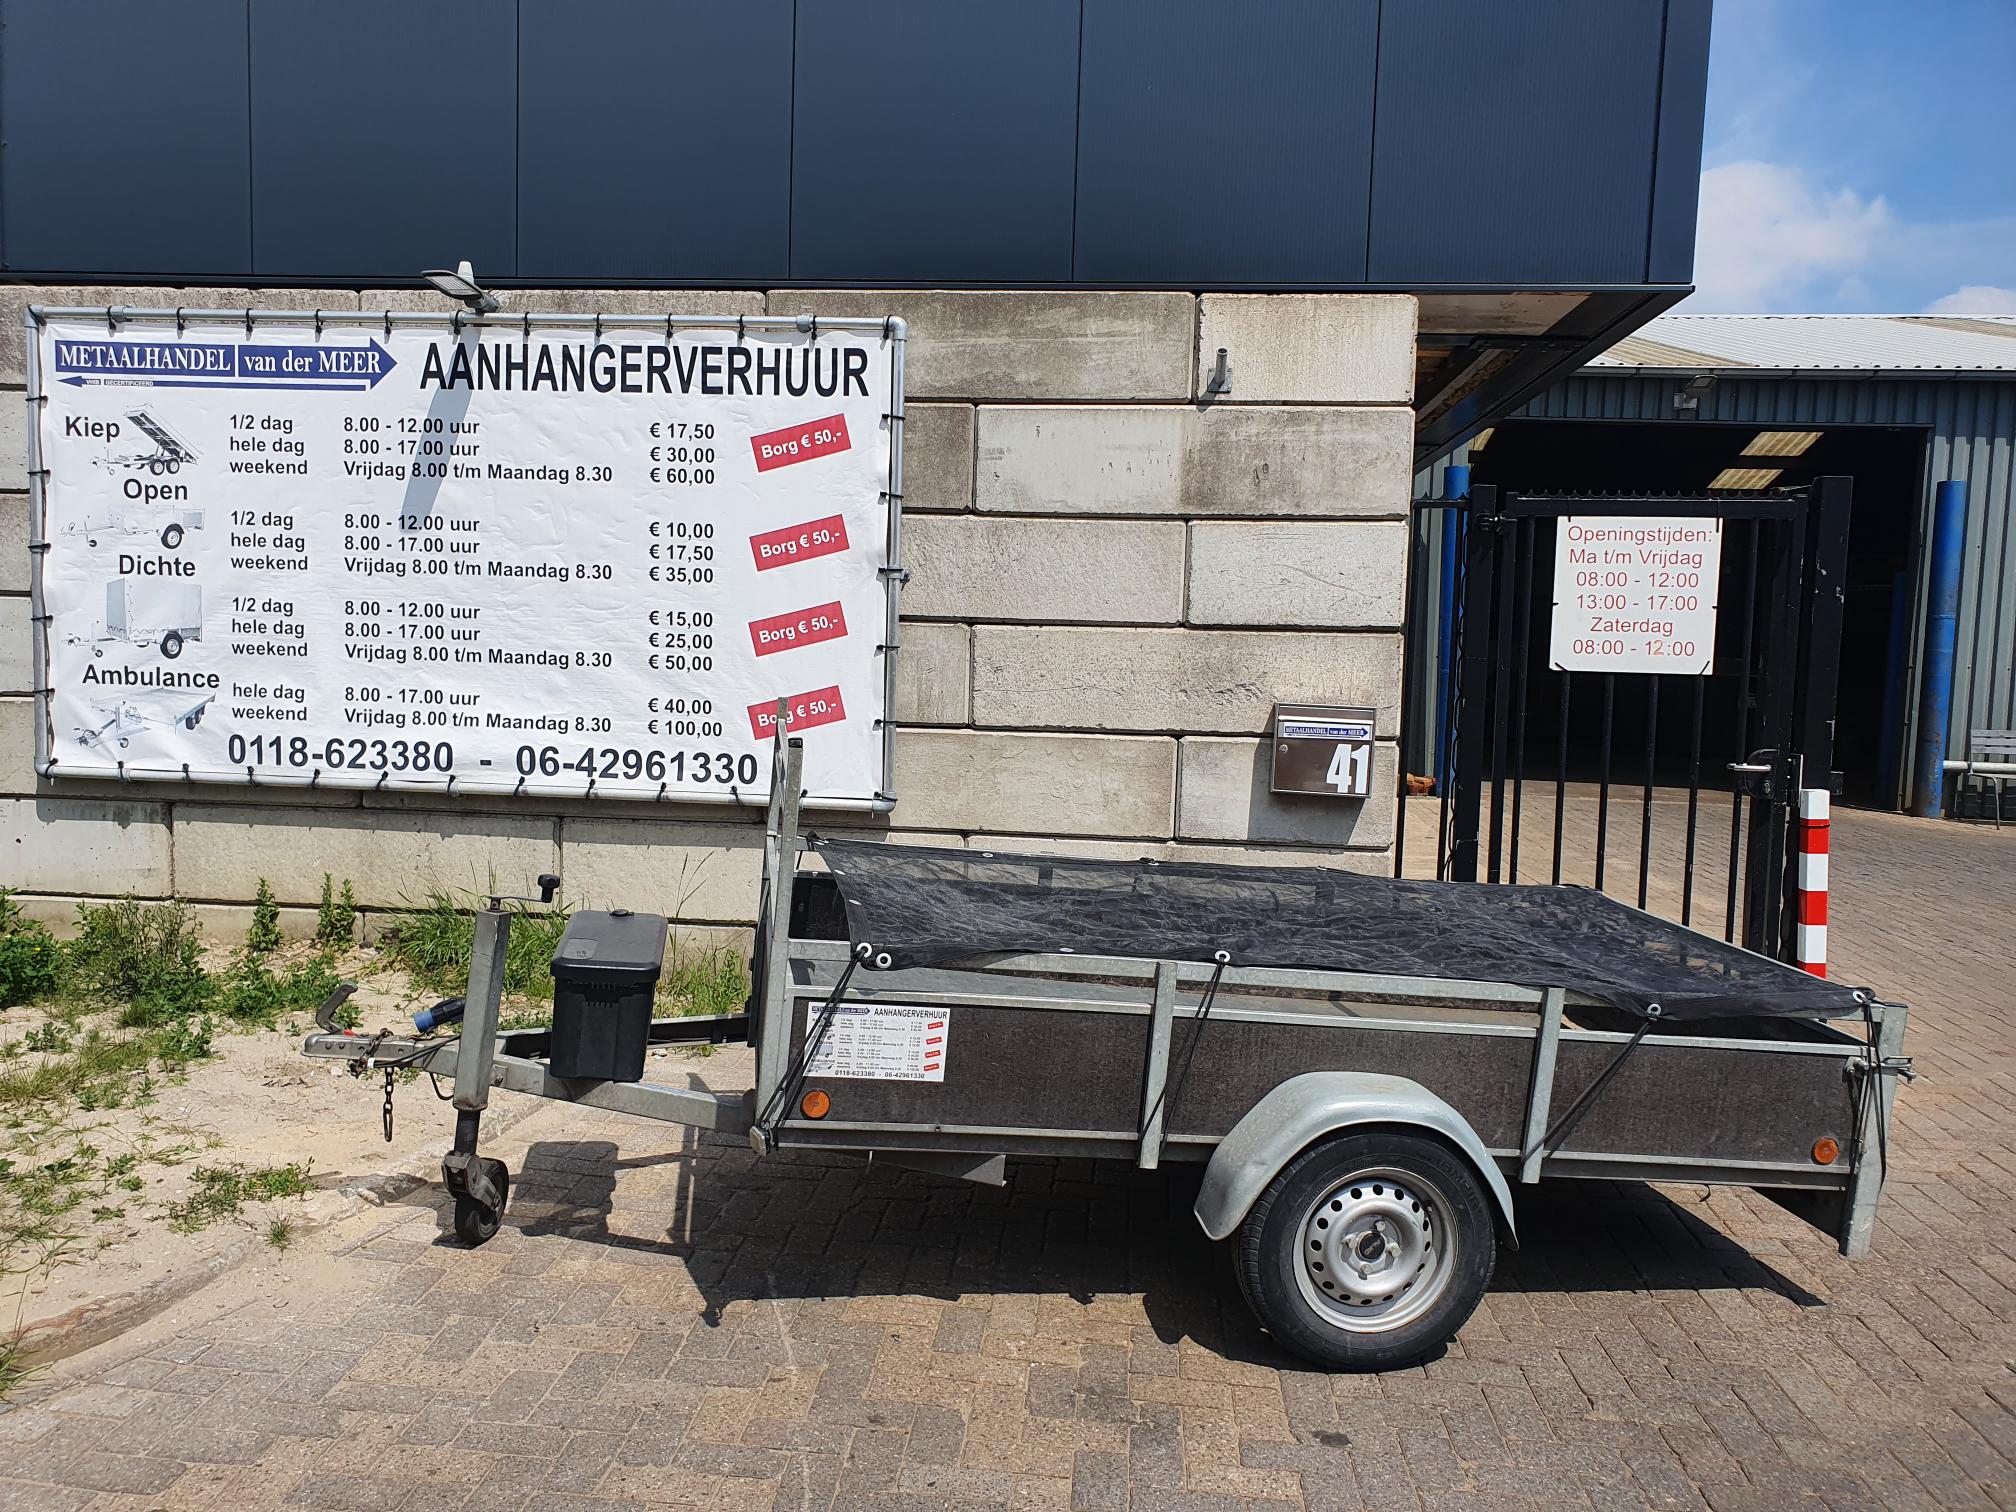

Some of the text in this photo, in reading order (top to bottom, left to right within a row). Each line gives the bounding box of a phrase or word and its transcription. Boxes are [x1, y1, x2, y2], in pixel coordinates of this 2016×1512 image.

[60, 344, 381, 374] METAALHANDEL van der MEER
[420, 342, 870, 397] AANHANGERVERHUUR
[66, 416, 119, 443] Kiep
[231, 415, 292, 434] 1/2 dag
[344, 417, 379, 432] 8.00
[398, 418, 443, 433] 12.00
[450, 423, 479, 433] uur
[650, 423, 714, 441] € 17,50
[231, 437, 304, 456] hele dag
[344, 439, 379, 454] 8.00
[398, 440, 443, 455] 17.00
[450, 445, 479, 456] uur
[762, 430, 841, 458] Borg € 50,-
[650, 447, 714, 465] € 30,00
[230, 459, 307, 474] weekend
[344, 461, 612, 484] Vrijdag 8.00 t/m Maandag 8.30
[650, 468, 714, 485] € 60,00
[124, 479, 187, 505] Open
[232, 511, 293, 530] 1/2 dag
[345, 514, 379, 529] 8.00
[399, 515, 443, 530] 12.00
[451, 520, 479, 531] uur
[649, 522, 713, 539] € 10,00
[1568, 526, 1711, 545] Openingstijden:
[231, 533, 304, 552] hele dag
[345, 536, 379, 550] 8.00
[399, 537, 443, 552] 17.00
[451, 542, 480, 553] uur
[760, 530, 839, 557] Borg € 50,-
[649, 544, 713, 562] € 17,50
[1570, 549, 1702, 568] Ma t/m Vrijdag
[120, 555, 195, 576] Dichte
[231, 555, 307, 570] weekend
[344, 557, 611, 582] Vrijdag 8.00 t/m Maandag 8.30
[649, 567, 713, 585] € 35,00
[1577, 572, 1627, 586] 08:00
[1649, 573, 1698, 587] 12:00
[233, 597, 293, 617] 1/2 dag
[345, 601, 380, 615] 8.00
[399, 603, 443, 618] 12.00
[451, 608, 480, 619] uur
[1577, 595, 1626, 609] 13:00
[1648, 596, 1697, 610] 17:00
[232, 619, 304, 638] hele dag
[649, 611, 712, 628] € 15,00
[1591, 617, 1672, 637] Zaterdag
[345, 623, 380, 637] 8.00
[399, 624, 444, 639] 17.00
[451, 630, 480, 640] uur
[759, 616, 837, 643] Borg € 50,-
[232, 641, 307, 656] weekend
[649, 633, 712, 651] € 25,00
[1573, 640, 1623, 654] 08:00
[1645, 640, 1694, 656] 12:00
[345, 644, 611, 669] Vrijdag 8.00 t/m Maandag 8.30
[649, 655, 712, 672] € 50,00
[82, 665, 219, 688] Ambulance
[233, 683, 304, 703] hele dag
[345, 687, 380, 702] 8.00
[399, 689, 443, 704] 17.00
[450, 694, 480, 705] uur
[232, 706, 306, 720] weekend
[648, 698, 711, 716] € 40,00
[757, 700, 837, 727] Bog € 50,-
[345, 709, 611, 734] Vrijdag 8.00 t/m Maandag 8.30
[648, 720, 722, 738] € 100,00
[229, 734, 453, 772] 0118-623380
[517, 746, 757, 784] 06-42961330
[1326, 743, 1370, 794] 41
[874, 1008, 947, 1019] AANHANGERVERHUUR
